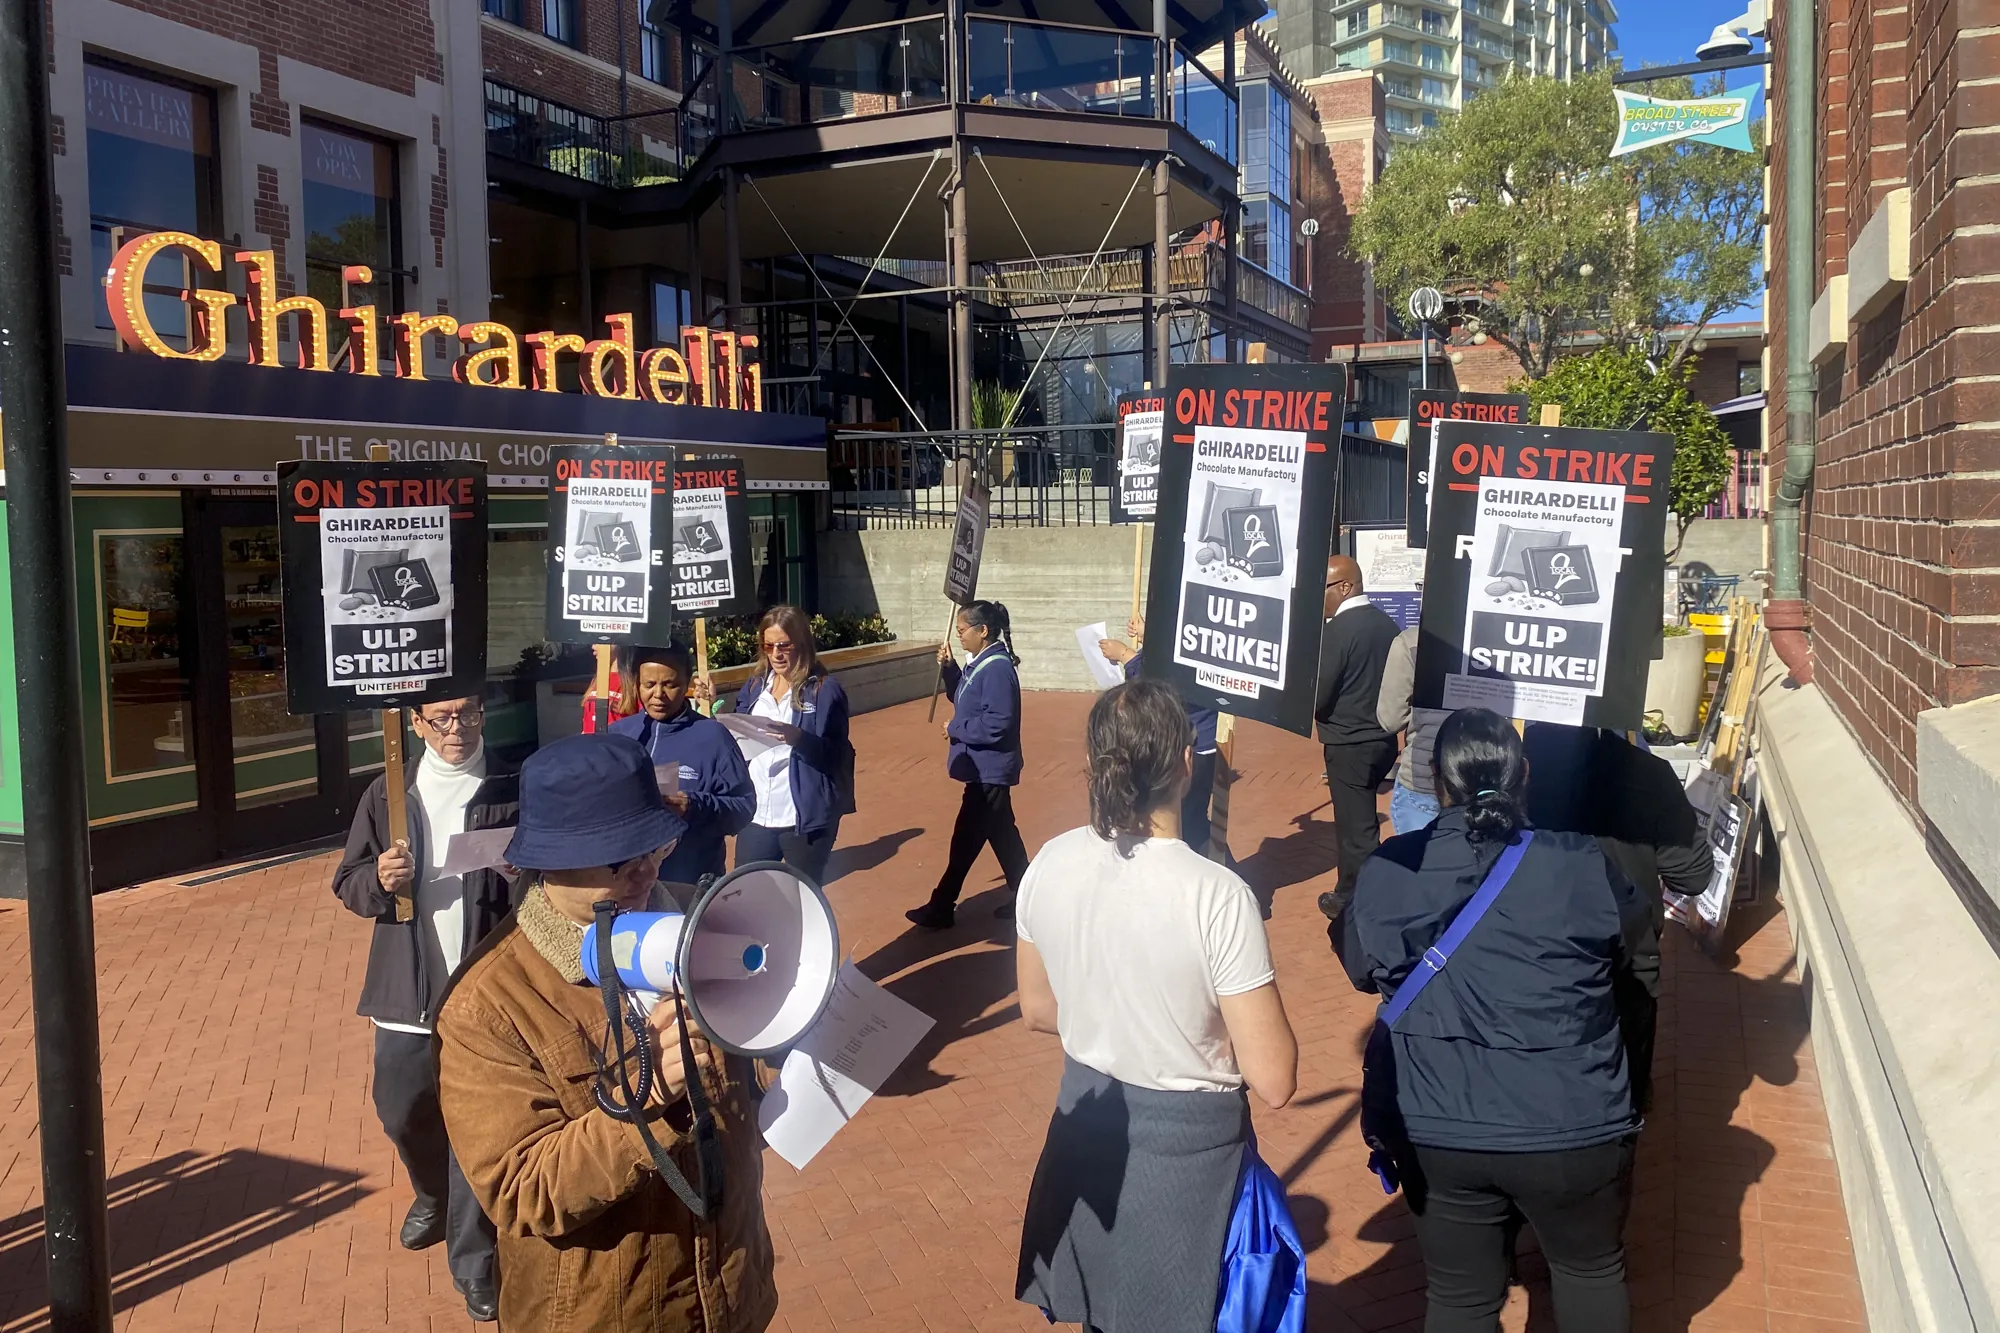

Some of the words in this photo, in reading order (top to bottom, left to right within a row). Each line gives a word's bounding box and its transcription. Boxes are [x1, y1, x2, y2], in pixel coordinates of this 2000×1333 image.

[88, 75, 192, 120] PREVIEW
[88, 98, 192, 139] GALLERY
[1624, 106, 1677, 121] BROAD
[1680, 103, 1741, 118] STREET
[1631, 120, 1686, 136] OYSTER
[319, 136, 357, 162] NOW
[317, 160, 362, 181] OPEN
[106, 231, 762, 412] Ghirardelli
[1120, 401, 1133, 417] ON
[1135, 397, 1164, 412] STRI
[1176, 388, 1216, 426] ON
[1222, 388, 1332, 431] STRIKE
[1418, 400, 1445, 419] ON
[1450, 402, 1519, 423] STRIKE
[1126, 416, 1163, 427] GHIRARDEL
[295, 435, 352, 460] THE
[1198, 440, 1299, 464] GHIRARDELLI
[556, 458, 582, 481] ON
[589, 459, 667, 483] STRIKE
[1196, 462, 1236, 475] Chocolate
[1238, 466, 1297, 483] Manufactory
[1451, 443, 1505, 476] ON
[1516, 446, 1655, 486] STRIKE
[673, 469, 738, 488] STRIKE
[1132, 476, 1154, 489] ULP
[294, 479, 344, 508] ON
[357, 478, 475, 508] STRIKE
[571, 486, 647, 498] GHIRARDELLI
[673, 493, 722, 505] RARDELLI
[1123, 488, 1158, 502] STRIKE
[1484, 488, 1616, 512] GHIRARDELLI
[571, 498, 603, 506] Chocolate
[604, 500, 646, 508] Manufactory
[326, 516, 444, 532] GHIRARDELLI
[1484, 507, 1539, 520] Chocolate
[1541, 512, 1614, 527] Manufactory
[327, 534, 378, 543] Chocolate
[381, 532, 444, 543] Manufactory
[678, 565, 712, 580] ULP
[586, 575, 626, 592] ULP
[671, 579, 730, 597] STRIKE!
[568, 594, 644, 614] STRIKE!
[1207, 594, 1257, 629] ULP
[582, 622, 629, 631] UNITEHERE!
[1504, 621, 1568, 649] ULP
[362, 627, 418, 650] ULP
[1182, 623, 1280, 672] STRIKE!
[334, 648, 446, 675] STRIKE!
[1471, 646, 1597, 683] STRIKE!
[358, 680, 424, 692] UNITEHERE!
[1198, 669, 1257, 693] UNITEHERE!
